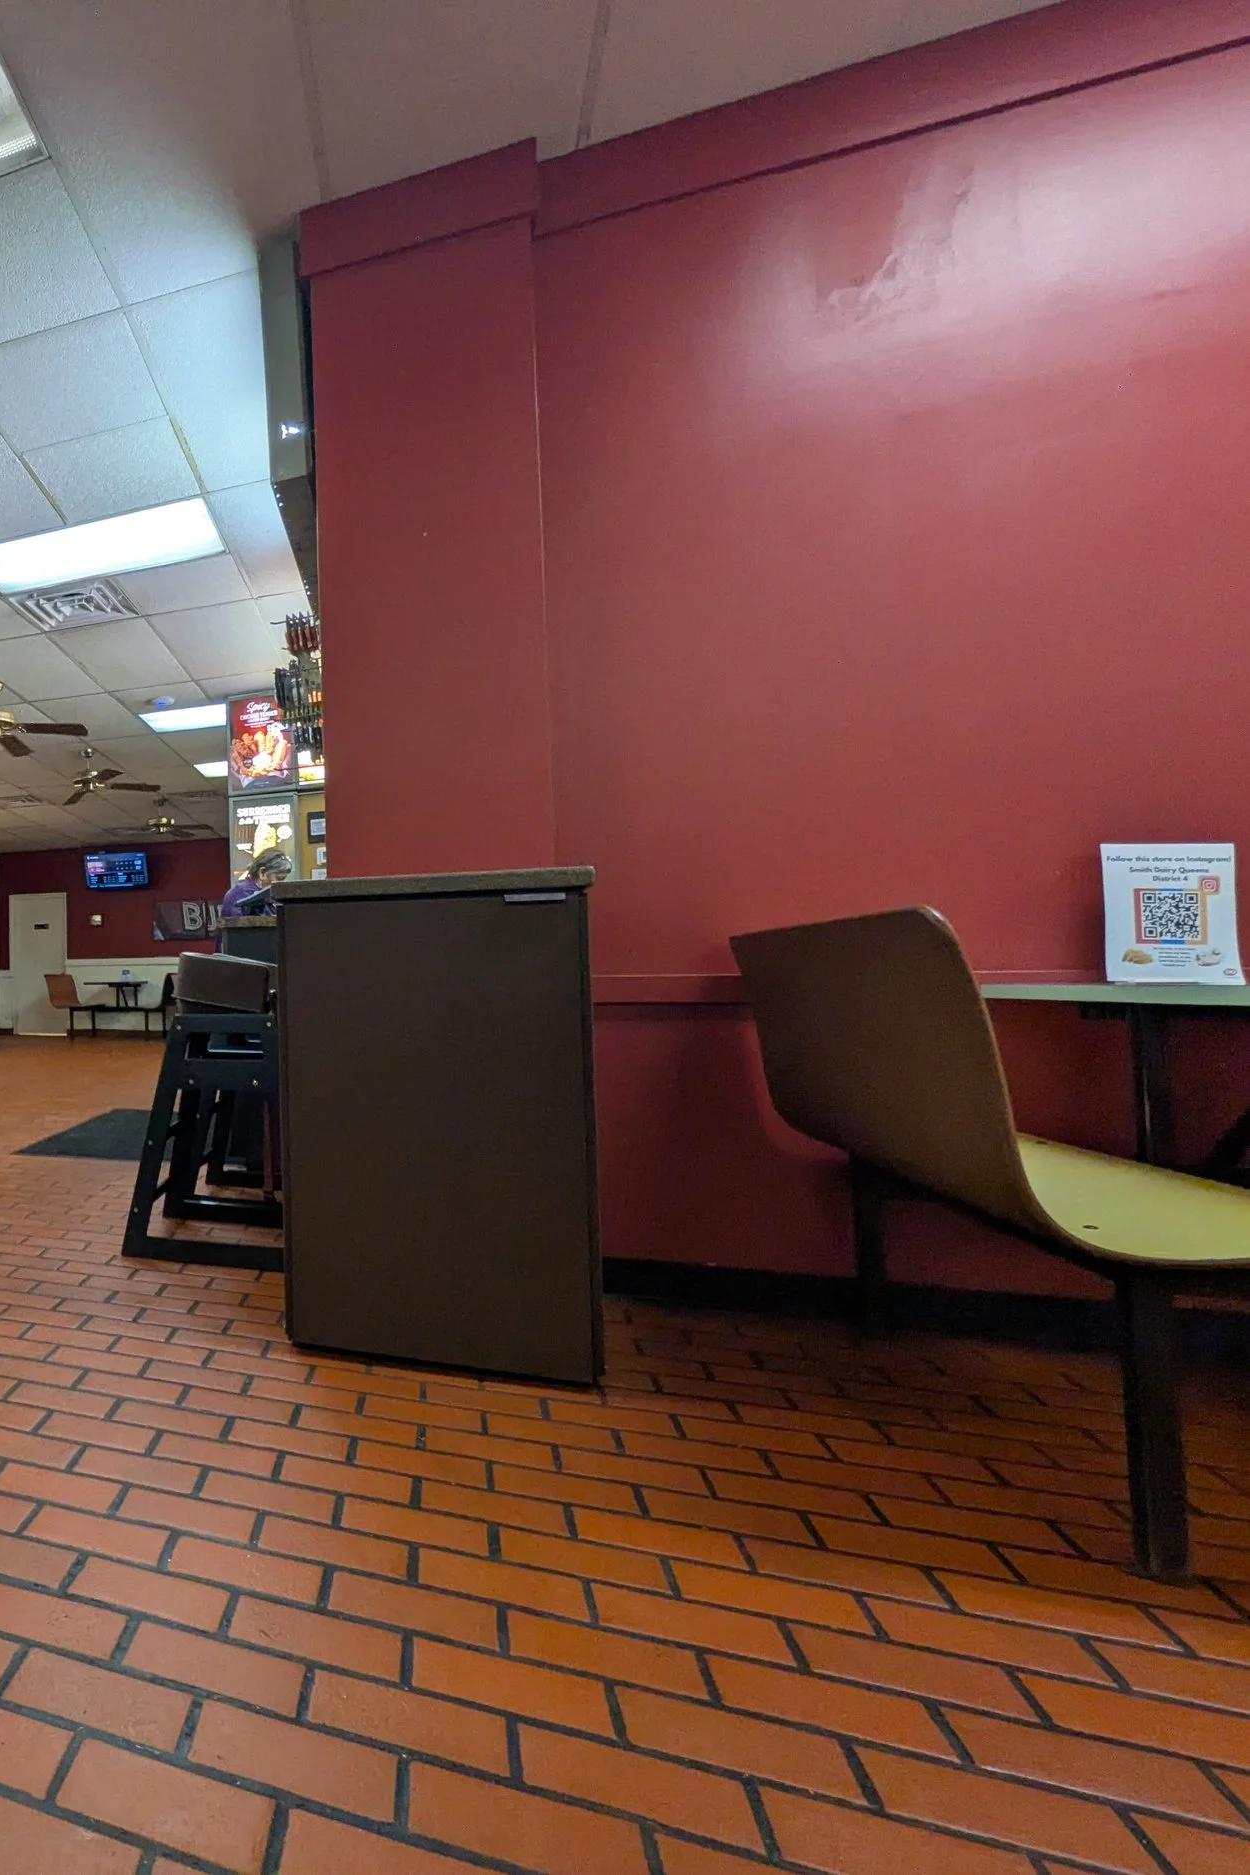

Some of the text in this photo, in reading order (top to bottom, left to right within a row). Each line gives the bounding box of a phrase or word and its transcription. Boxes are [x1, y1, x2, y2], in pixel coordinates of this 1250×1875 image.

[246, 701, 270, 713] Spicy
[237, 804, 290, 817] SURRENDER
[1106, 855, 1133, 863] Follow
[1187, 855, 1231, 864] Instagram!
[1154, 866, 1177, 874] Dairy
